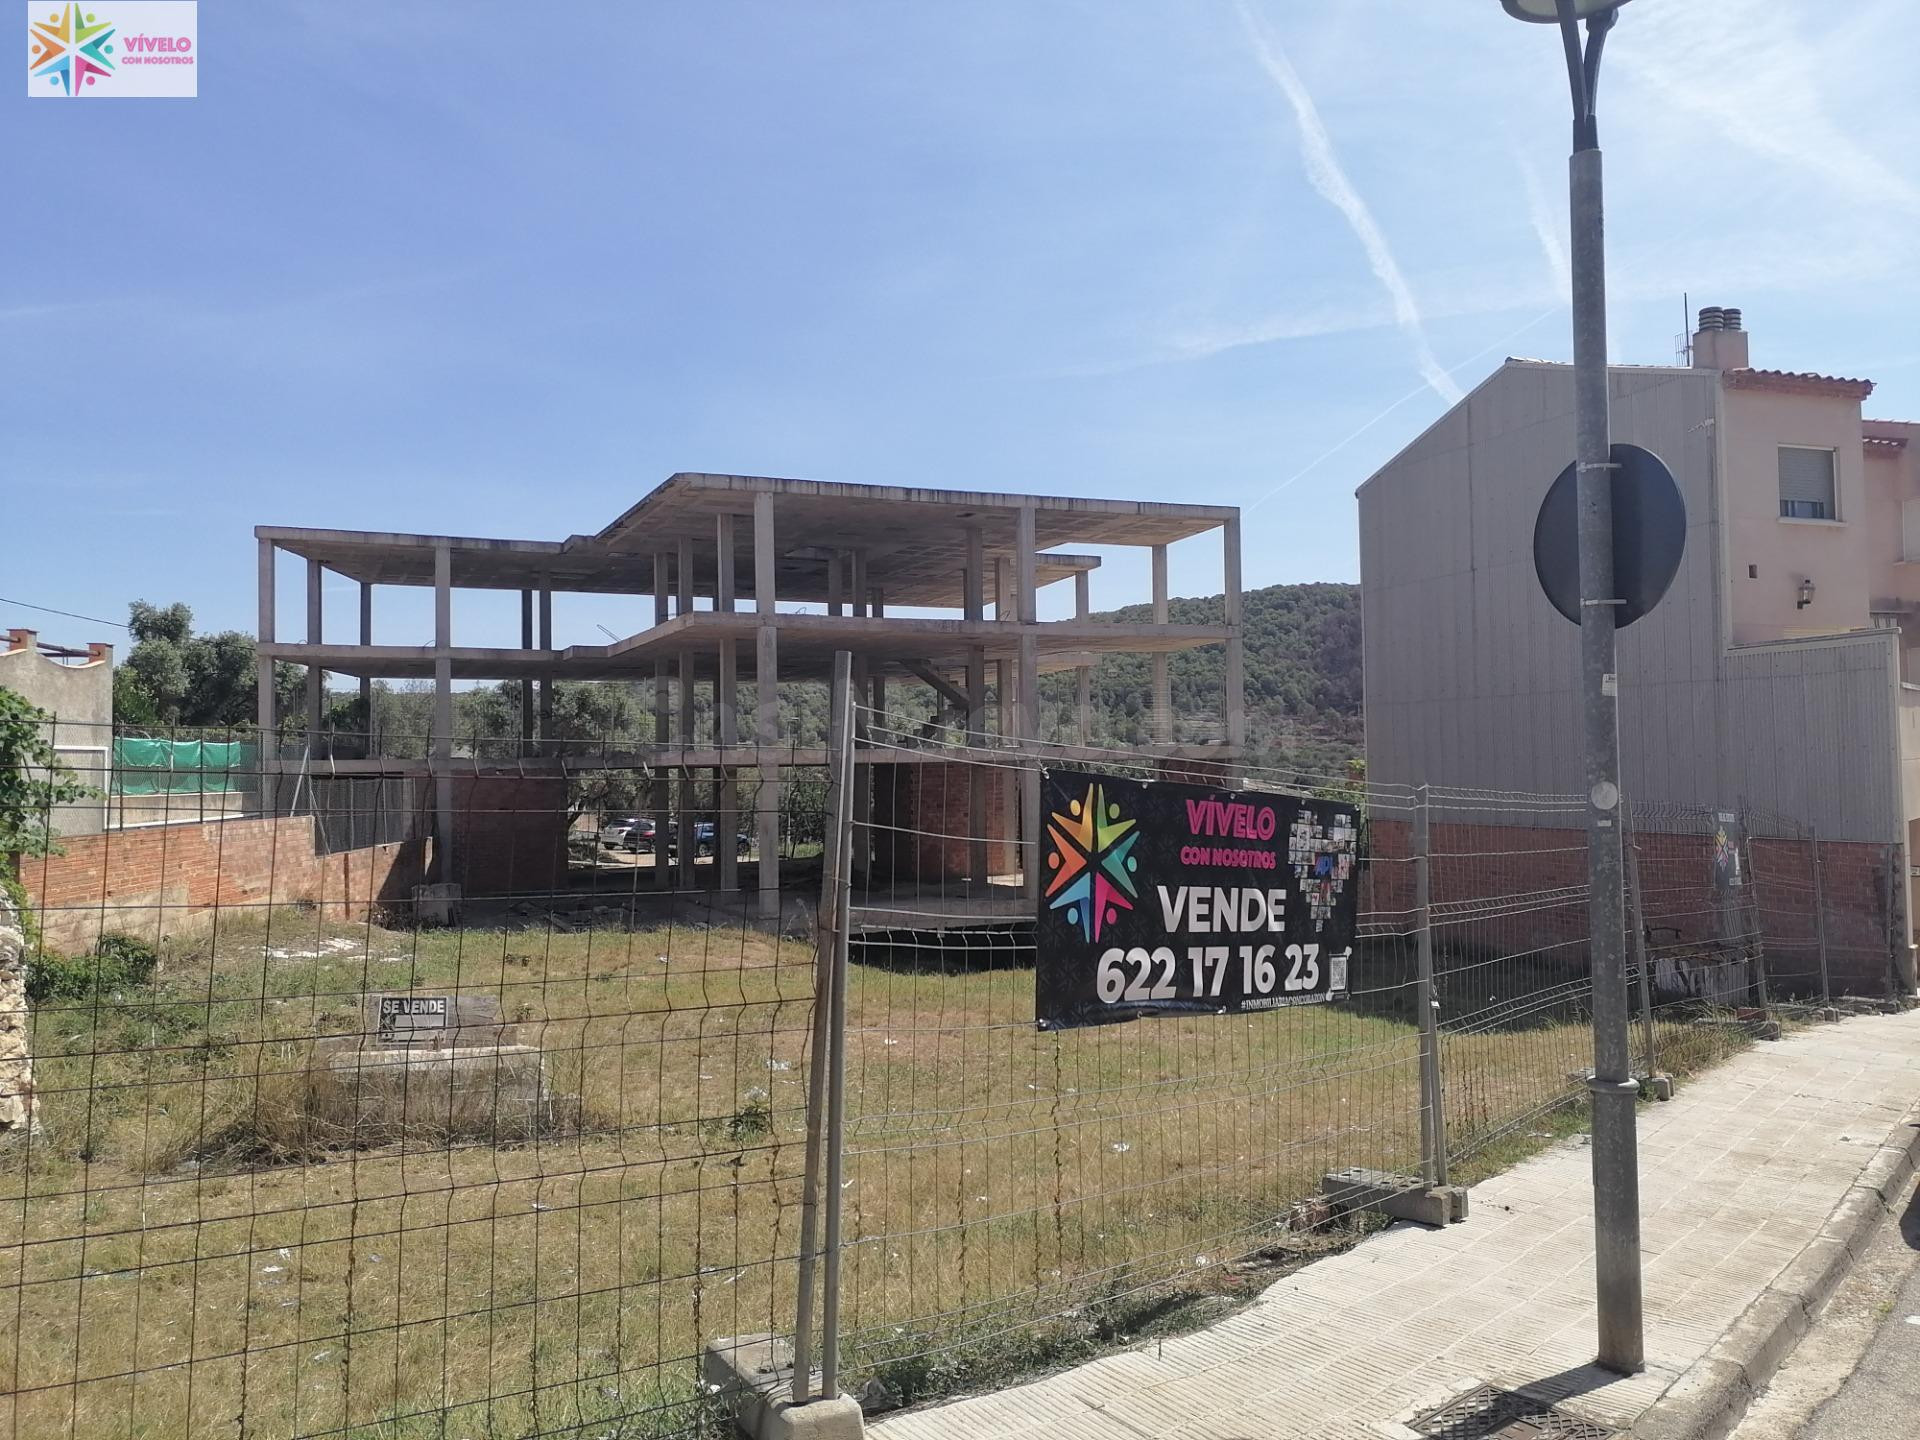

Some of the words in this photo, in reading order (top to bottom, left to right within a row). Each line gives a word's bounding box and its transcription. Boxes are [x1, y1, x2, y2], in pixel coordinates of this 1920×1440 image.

[1186, 794, 1276, 841] VÍVELO
[1180, 846, 1211, 866] CON
[1212, 848, 1276, 869] NOSOTROS
[1156, 885, 1286, 933] VENDE
[1096, 946, 1176, 1004] 622
[1187, 946, 1229, 997] 17
[1239, 944, 1276, 994] 16
[1284, 943, 1319, 991] 23
[382, 999, 400, 1014] SE
[402, 1000, 445, 1014] VENDE
